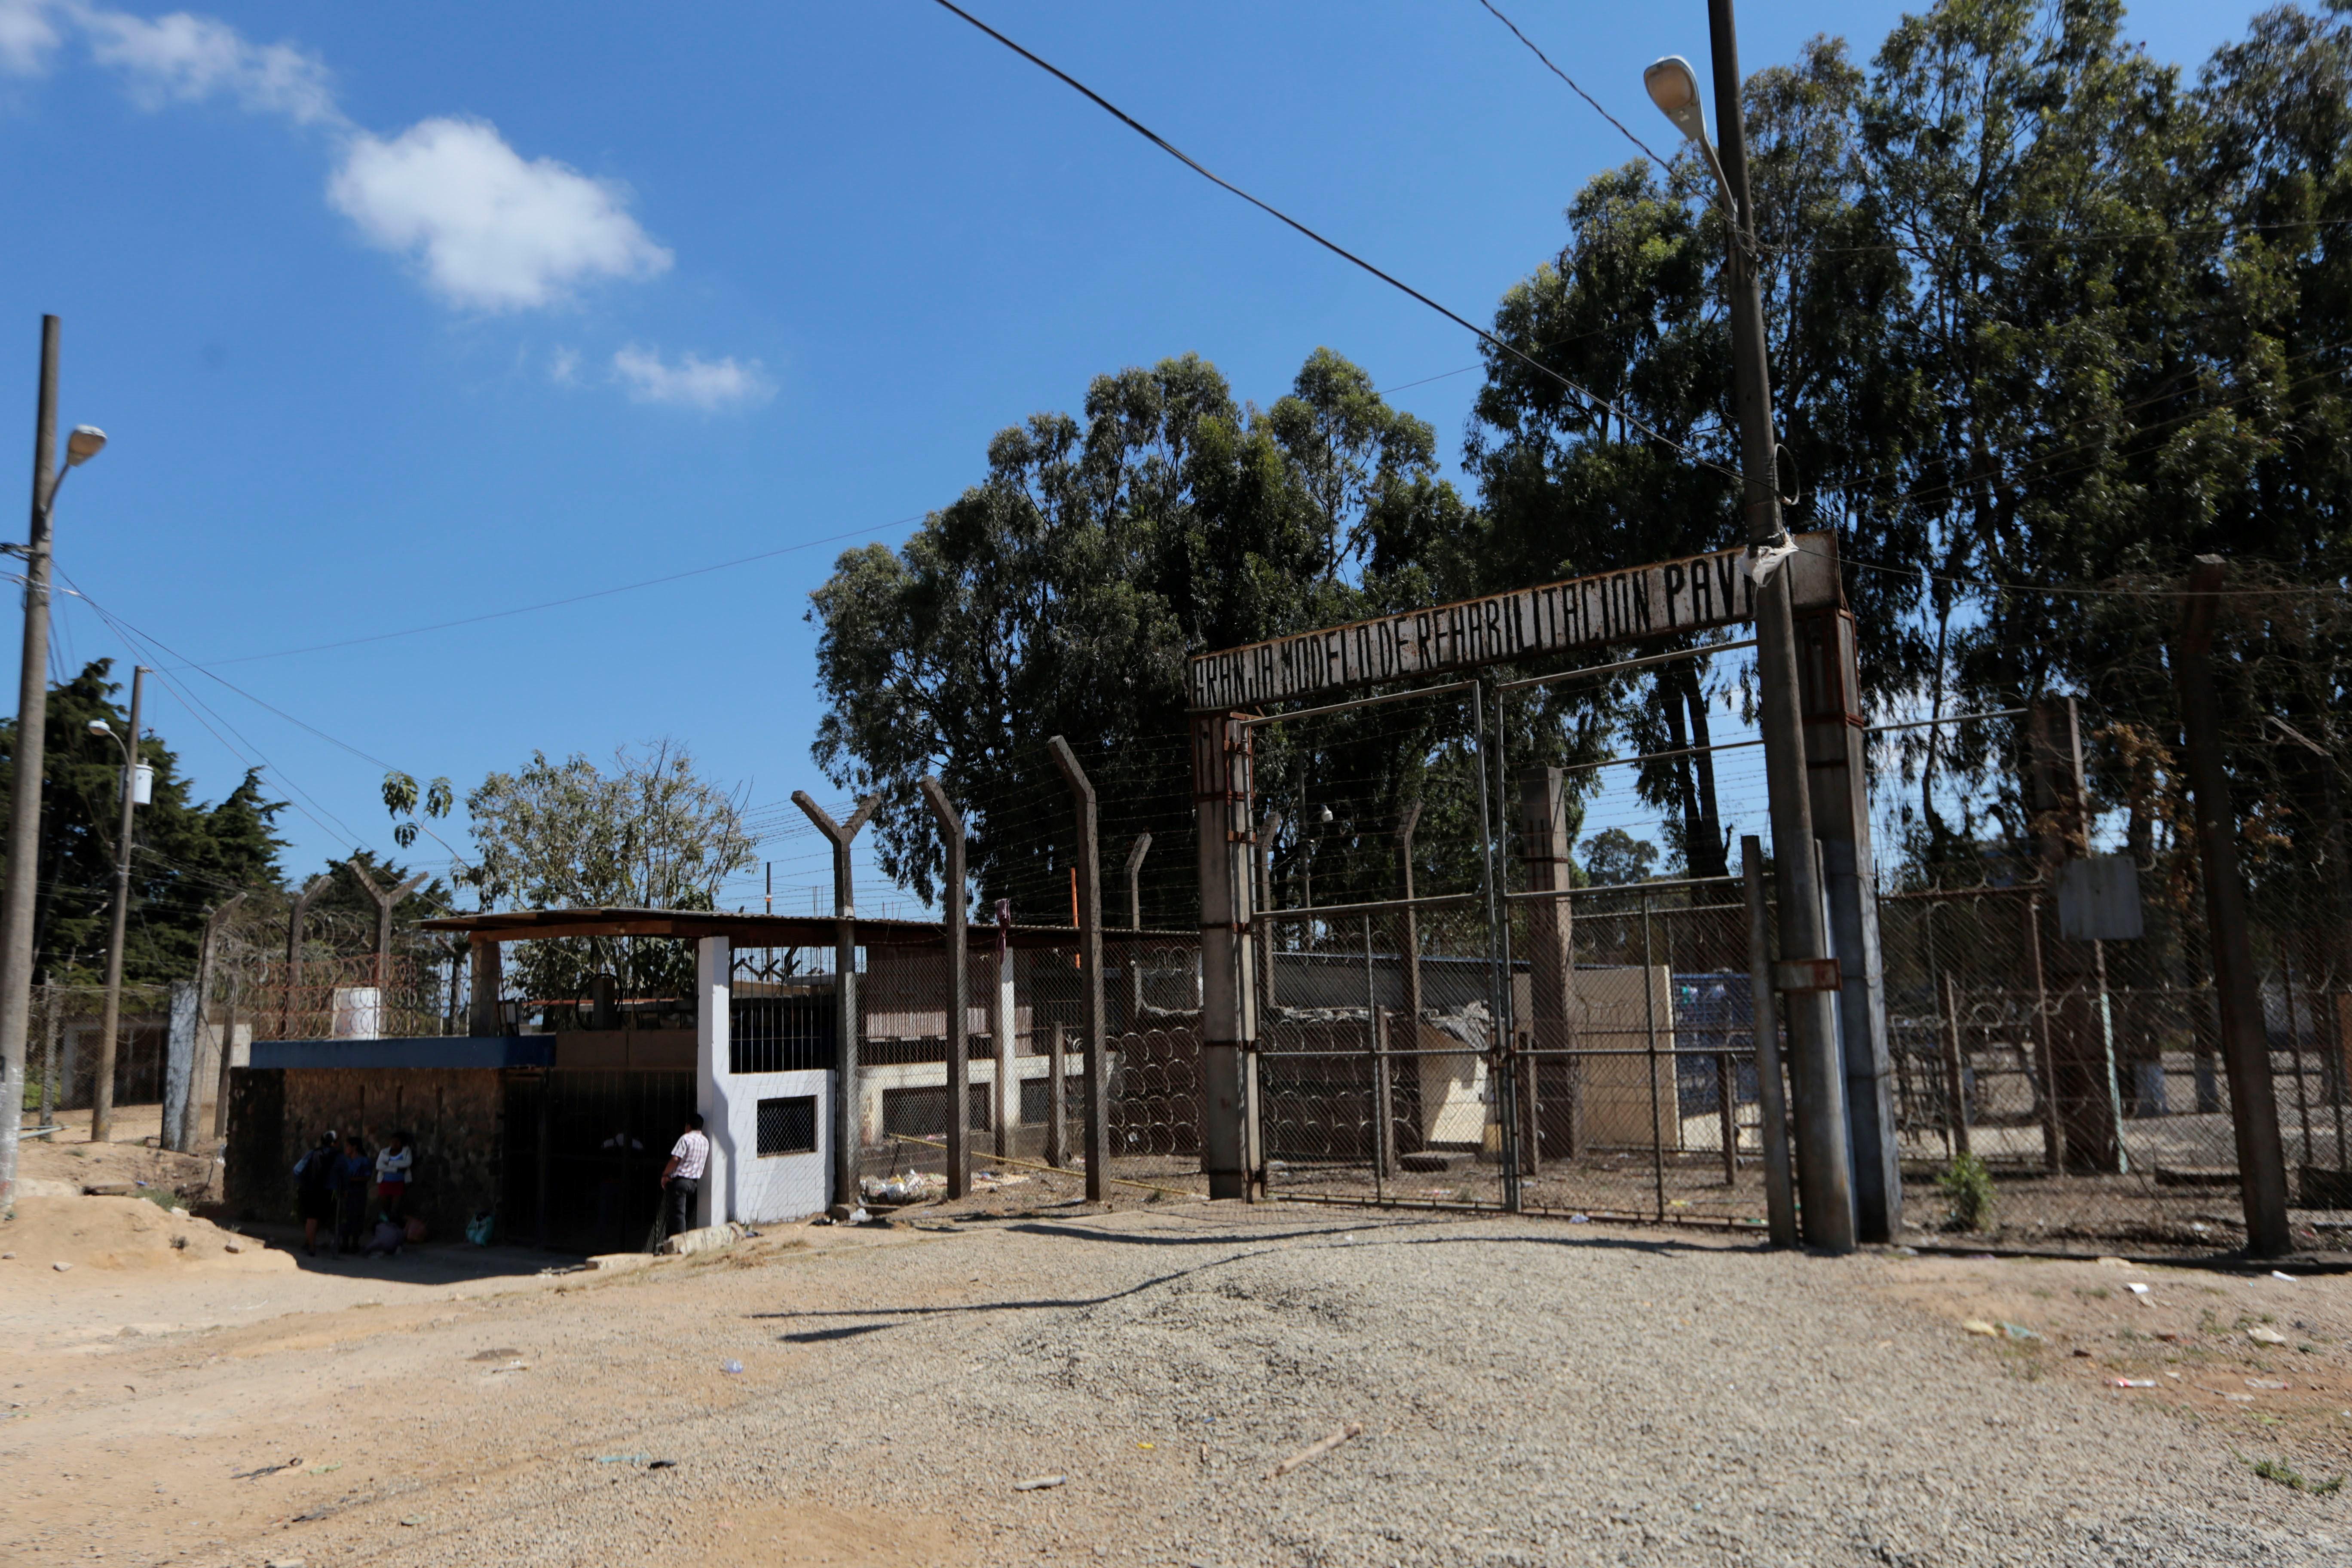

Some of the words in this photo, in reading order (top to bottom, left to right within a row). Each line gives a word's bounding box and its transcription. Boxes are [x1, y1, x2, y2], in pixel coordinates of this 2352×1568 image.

[1280, 625, 1372, 695] MODELO
[1378, 617, 1411, 679] DE
[1417, 570, 1651, 670] REHABILITACION
[1664, 553, 1754, 626] PAV
